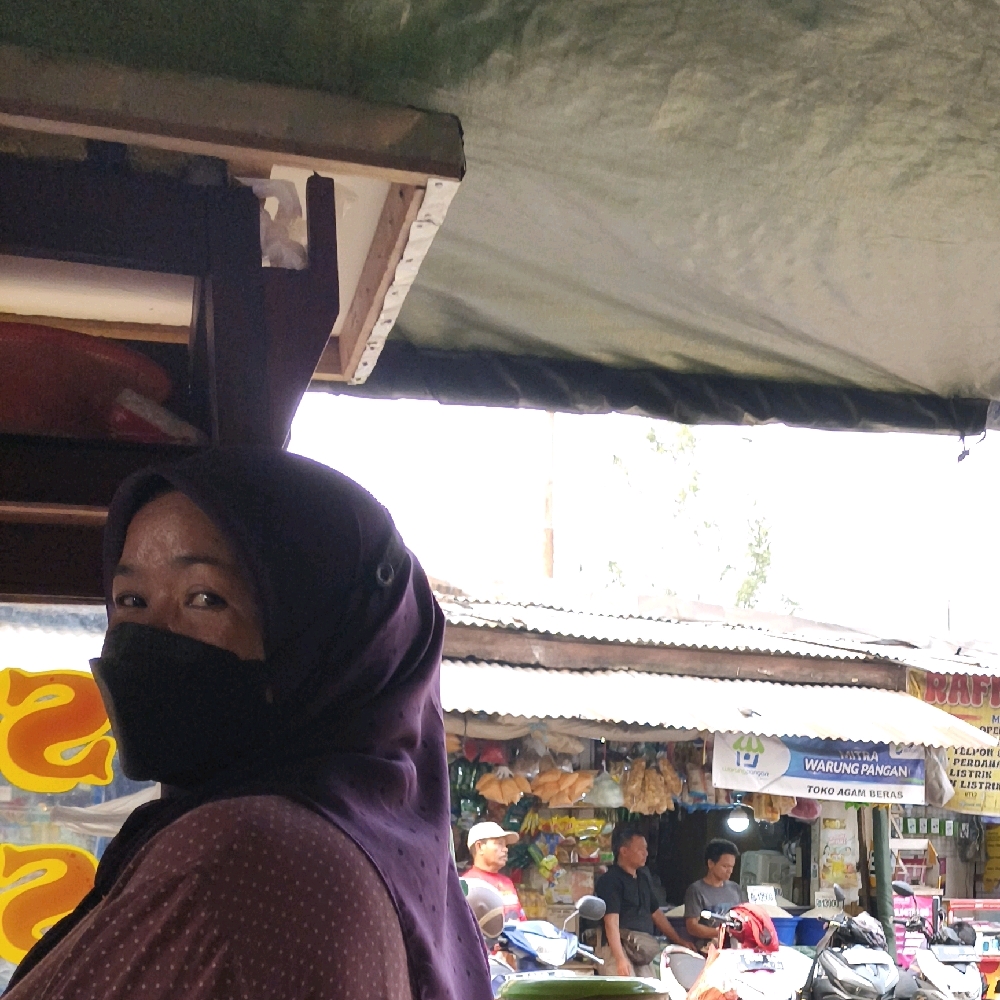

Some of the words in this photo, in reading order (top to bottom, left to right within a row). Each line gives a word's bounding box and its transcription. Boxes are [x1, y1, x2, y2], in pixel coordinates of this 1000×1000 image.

[803, 757, 860, 775] WARUNG
[861, 761, 908, 778] PANGAN
[949, 768, 992, 779] LISTRIK
[806, 784, 835, 796] TOKO
[837, 787, 867, 798] AGAM
[869, 788, 904, 799] BERAS
